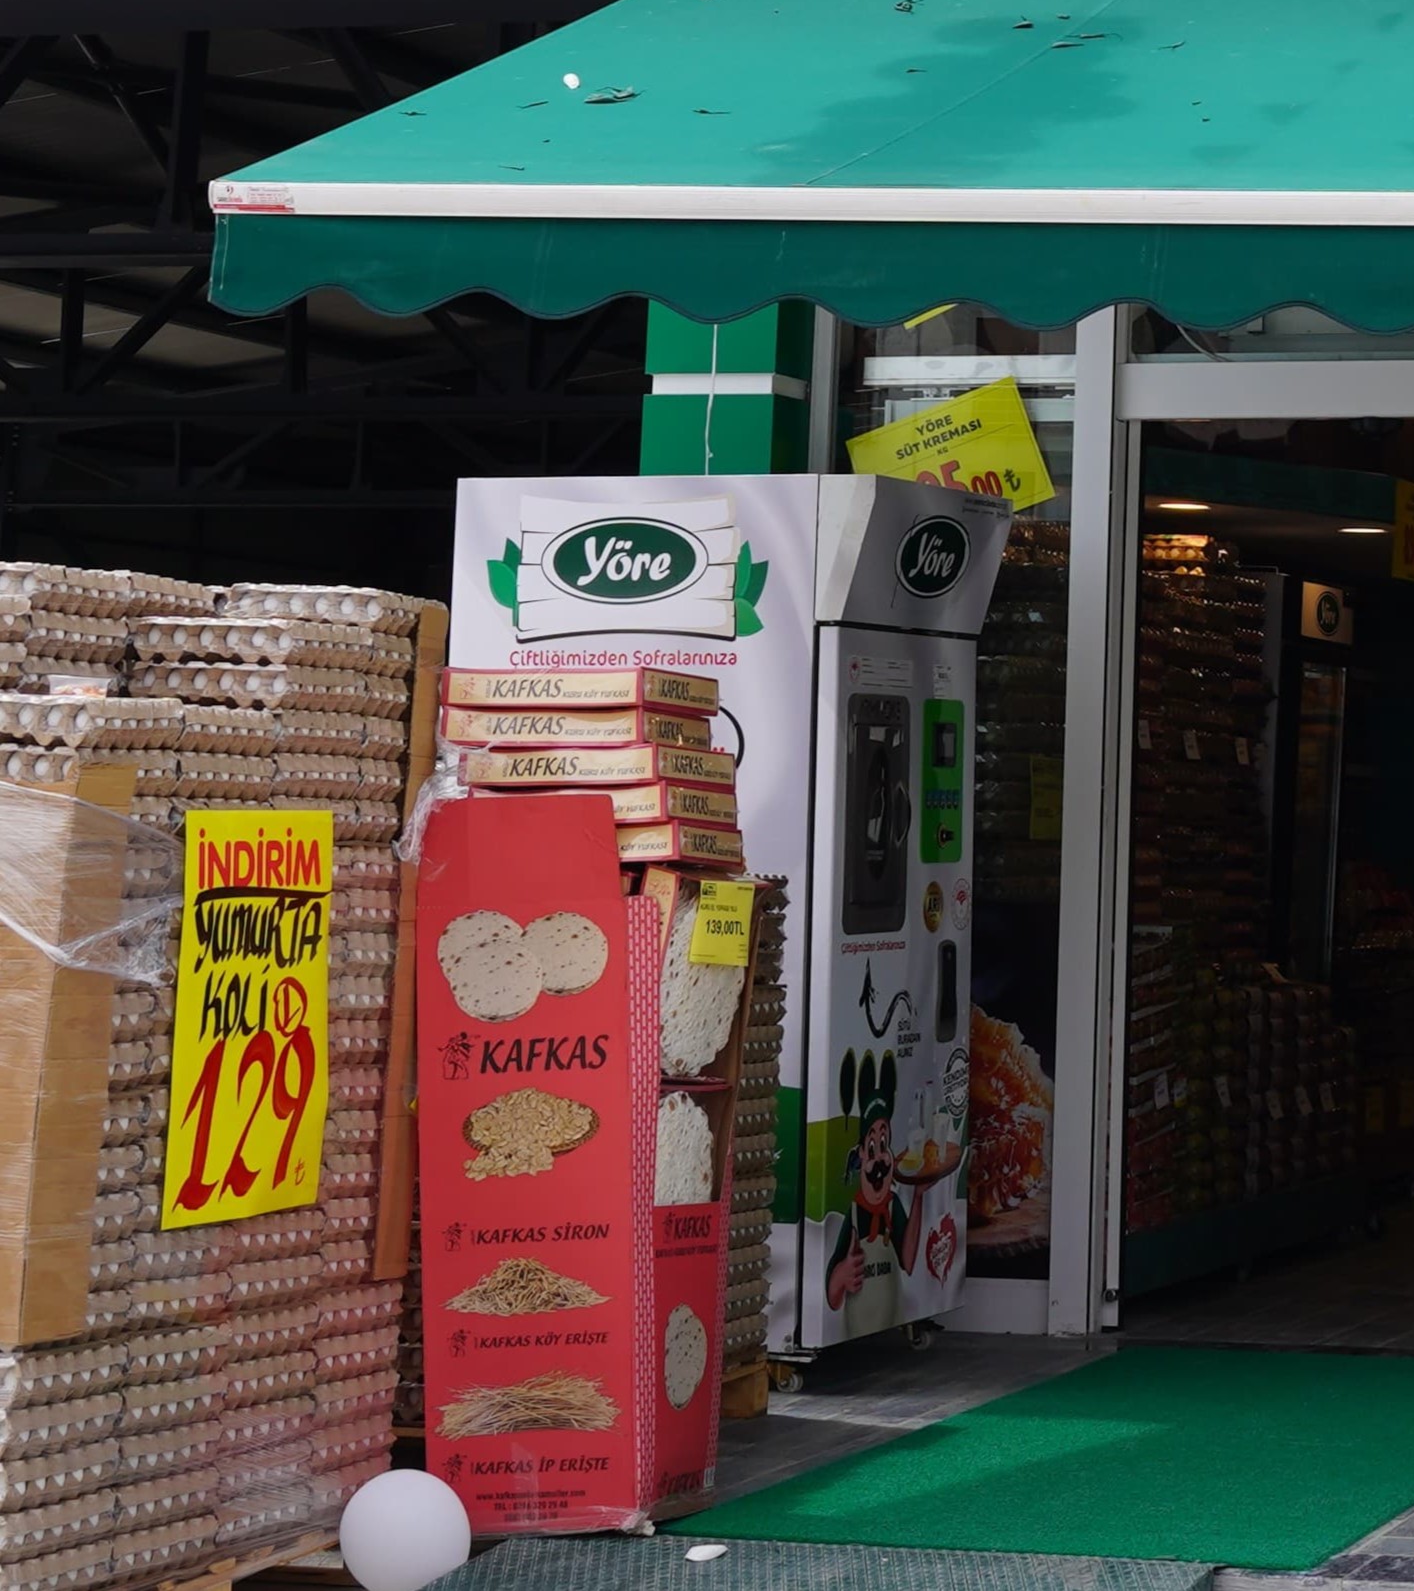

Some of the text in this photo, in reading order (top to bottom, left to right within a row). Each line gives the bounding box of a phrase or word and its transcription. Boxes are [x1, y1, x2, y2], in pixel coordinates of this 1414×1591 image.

[915, 414, 953, 437] YÖRE
[896, 418, 982, 460] SÜT KREMASI
[577, 536, 672, 586] Yöre
[509, 649, 738, 672] Çiftliğimizden Sofralarınıza
[492, 677, 564, 699] KAFKAS
[660, 678, 689, 701] KAFKAS
[493, 715, 565, 736] KAFKAS
[509, 755, 580, 777] KAFKAS
[198, 826, 322, 891] İNDİRİM
[706, 918, 744, 936] 139,00TL
[480, 1033, 610, 1075] KAFKAS
[172, 1024, 316, 1211] 129
[476, 1220, 610, 1245] KAFKAS SİRON
[674, 1214, 712, 1239] KAFKAS
[480, 1329, 609, 1350] KAFKAS KÖY ERİŞTE
[474, 1456, 609, 1476] KAFKAS İP ERİŞTE
